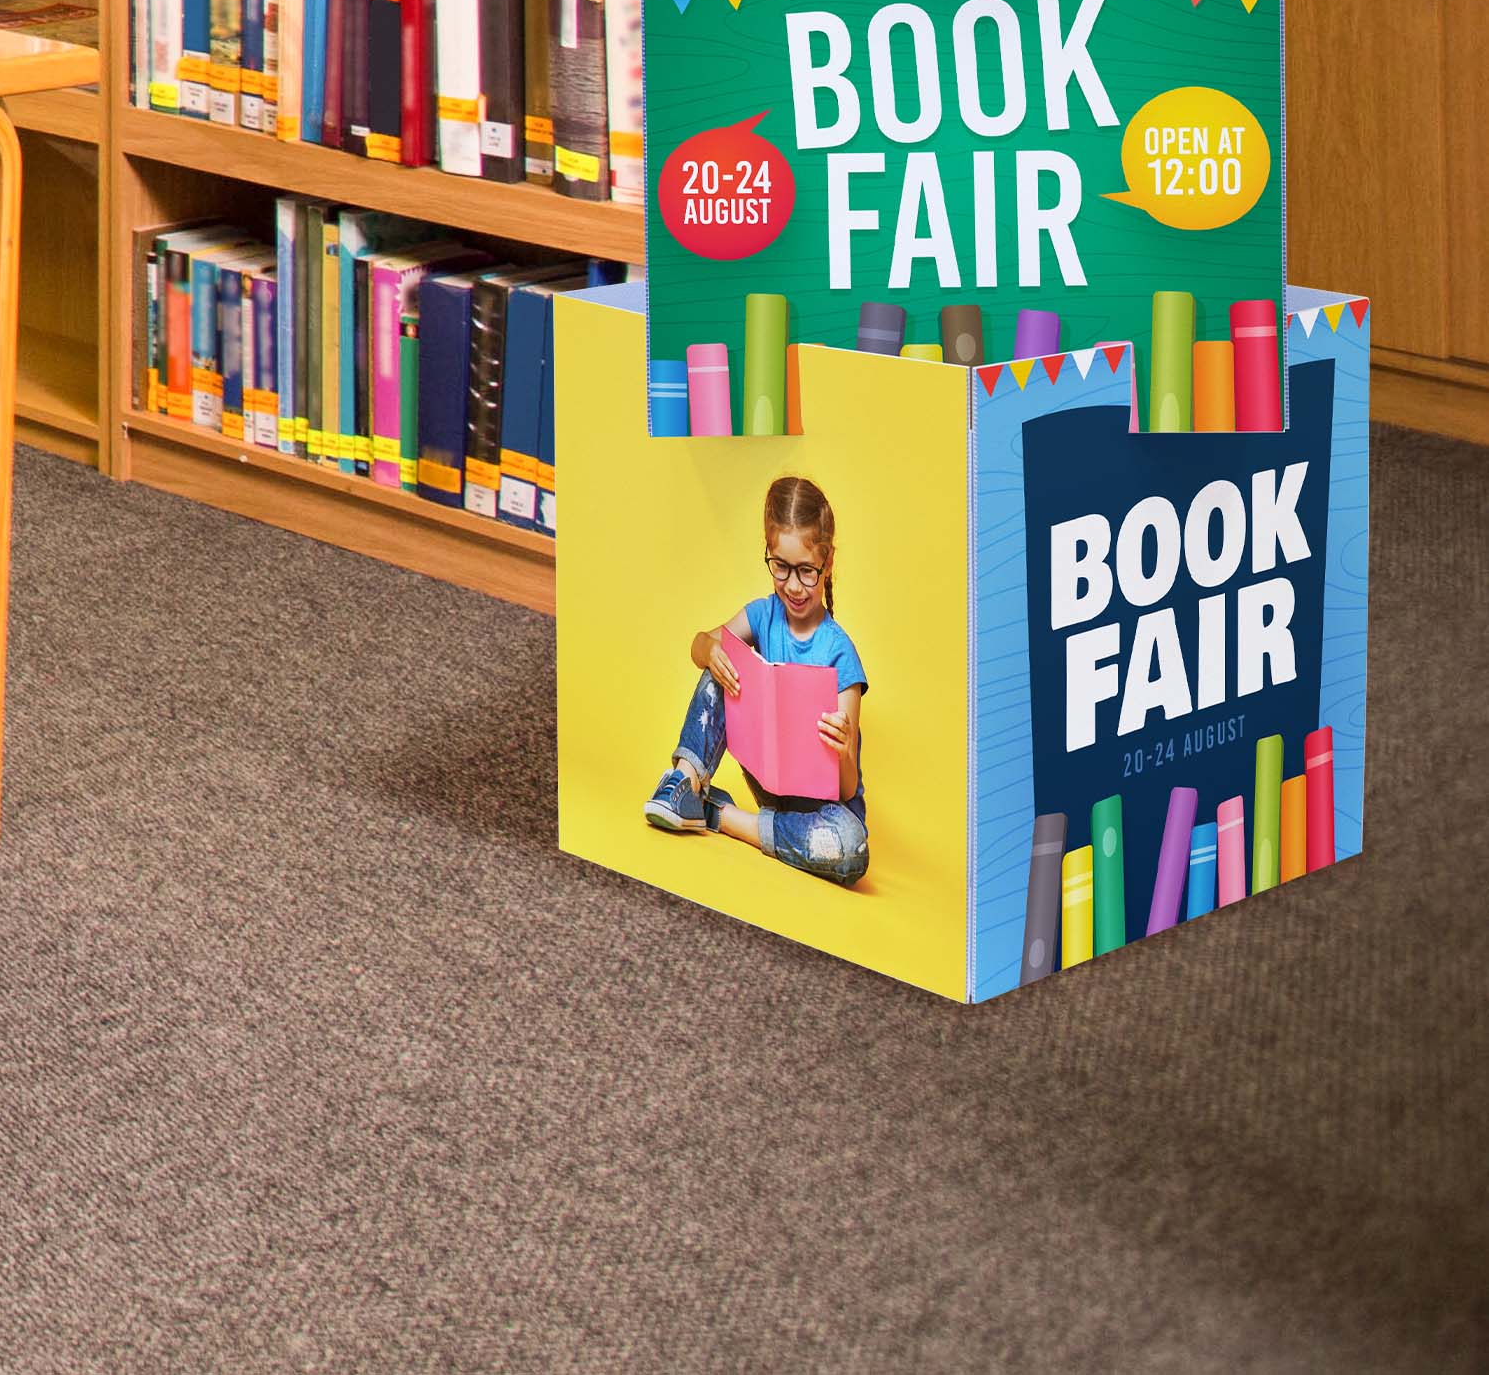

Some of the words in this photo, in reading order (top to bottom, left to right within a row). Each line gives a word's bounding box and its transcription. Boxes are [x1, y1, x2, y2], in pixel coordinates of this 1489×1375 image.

[1144, 126, 1209, 156] OPEN
[1217, 126, 1246, 155] AT
[682, 160, 772, 195] 20-24
[1147, 157, 1242, 196] 12:00
[683, 198, 772, 225] AUGUST
[827, 150, 1089, 290] FAIR
[1050, 461, 1312, 631] BOOK
[1066, 577, 1297, 753] FAIR
[1123, 737, 1175, 778] 20-24
[1183, 714, 1246, 758] AUGUST
